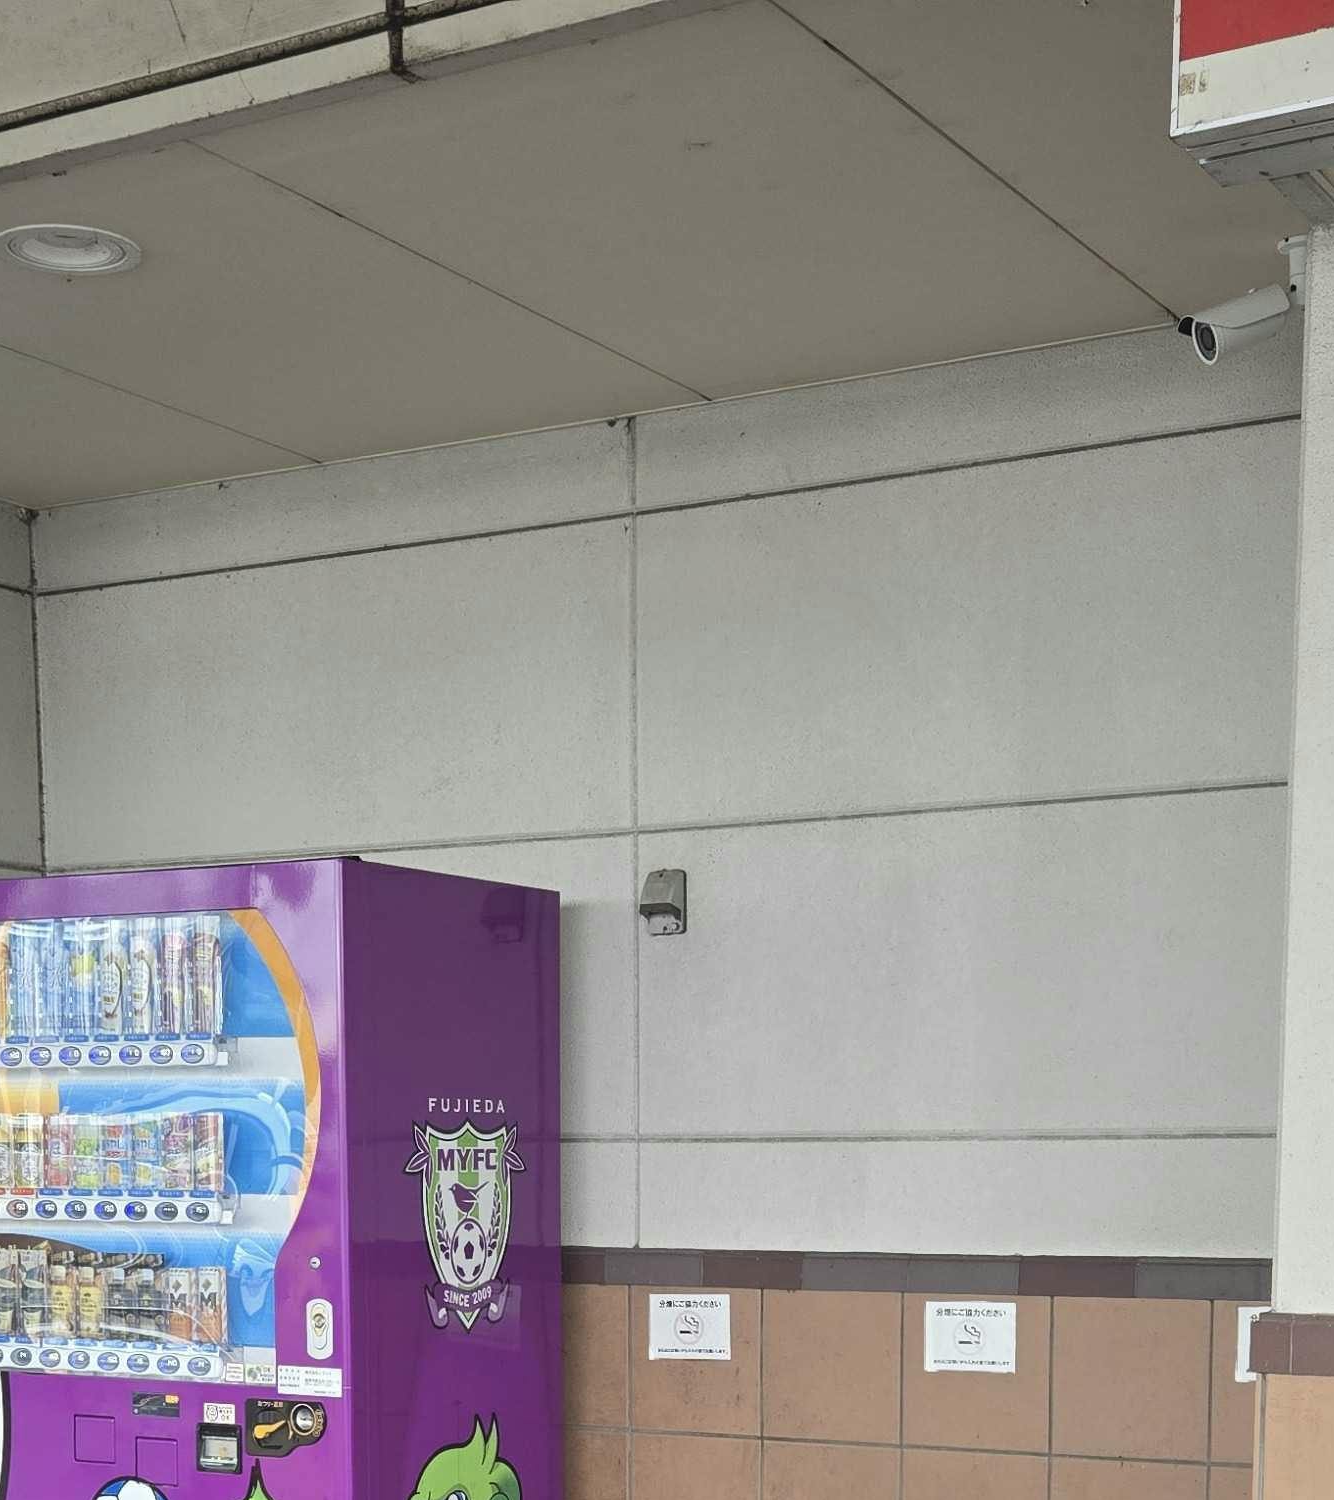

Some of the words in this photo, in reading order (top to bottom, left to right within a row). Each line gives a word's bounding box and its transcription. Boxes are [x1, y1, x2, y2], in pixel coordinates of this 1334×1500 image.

[427, 1097, 506, 1114] FUJIEDA
[436, 1147, 498, 1172] MYFC
[442, 1289, 471, 1308] SINCE
[471, 1286, 493, 1306] 2009
